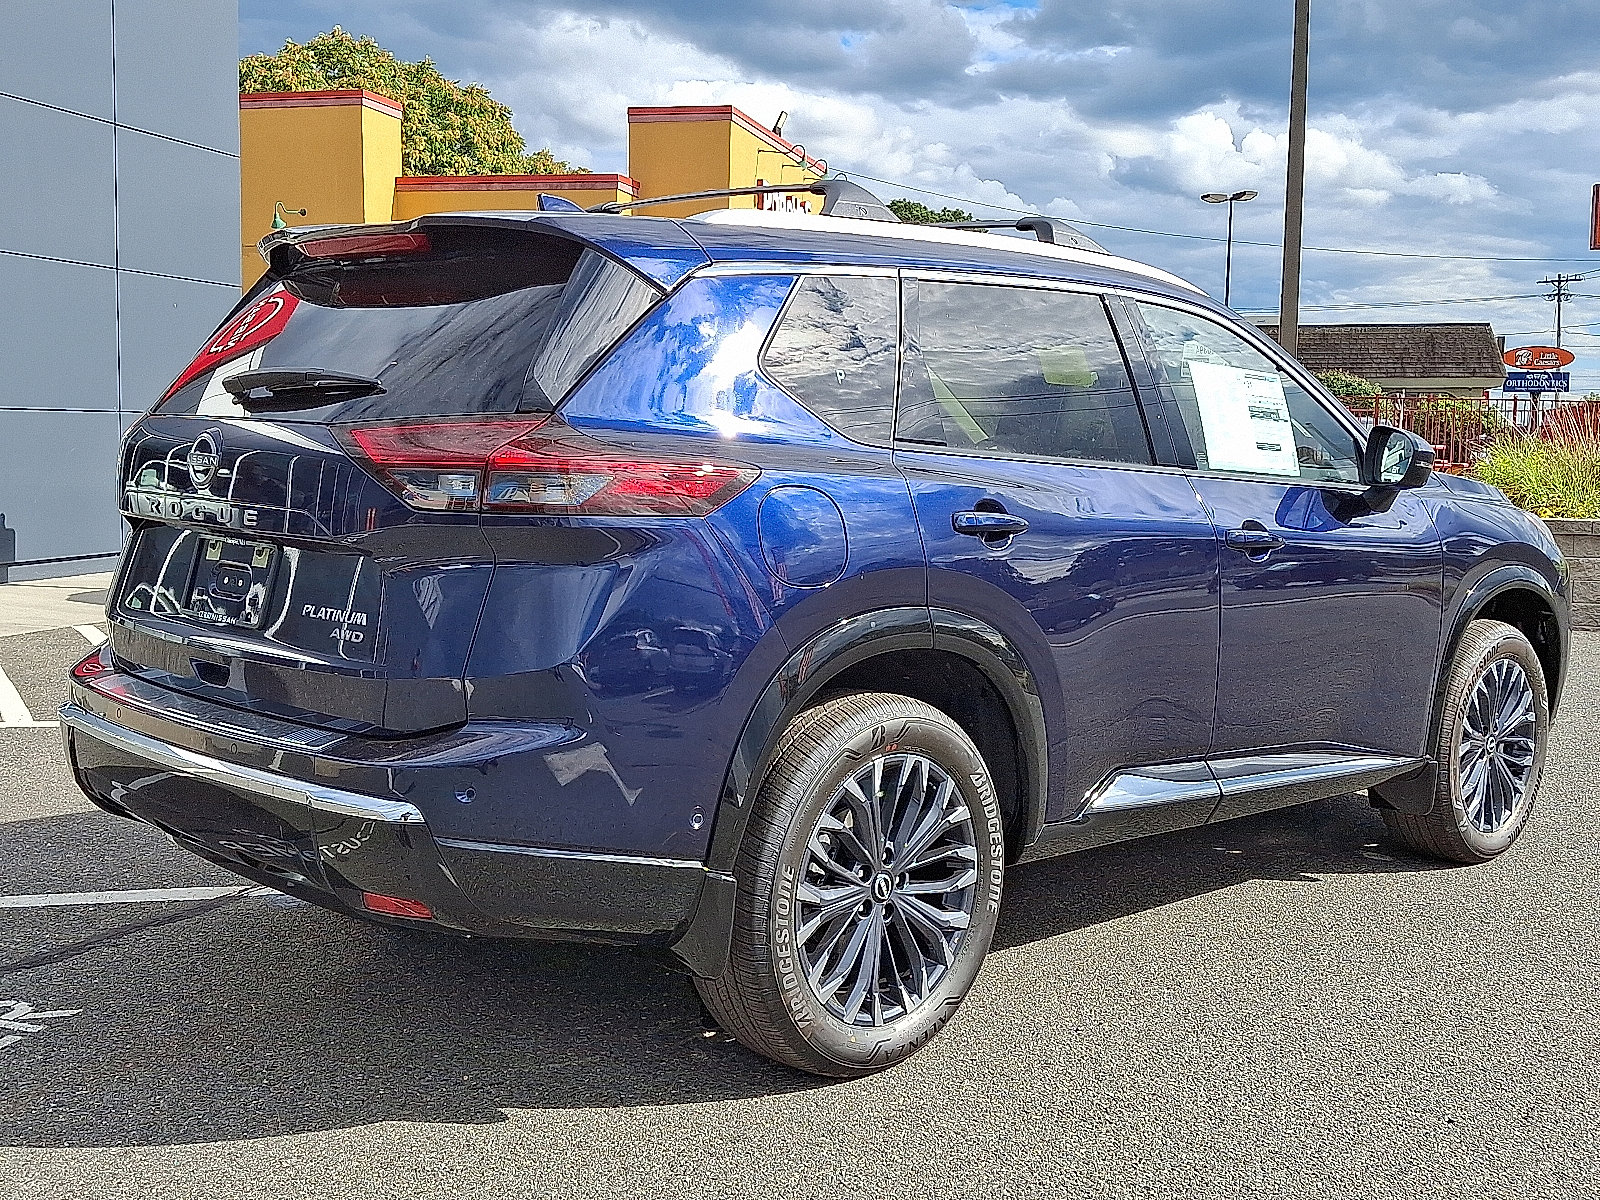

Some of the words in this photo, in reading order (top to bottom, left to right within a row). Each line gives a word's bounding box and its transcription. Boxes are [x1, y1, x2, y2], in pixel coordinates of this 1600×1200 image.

[147, 497, 258, 527] ROGUE
[302, 604, 367, 626] PLATINUM
[330, 627, 364, 643] AWD
[968, 769, 1004, 914] BRIDGESTONE
[771, 865, 815, 1030] BRIDGESTONE
[885, 1010, 948, 1061] ALENZA
